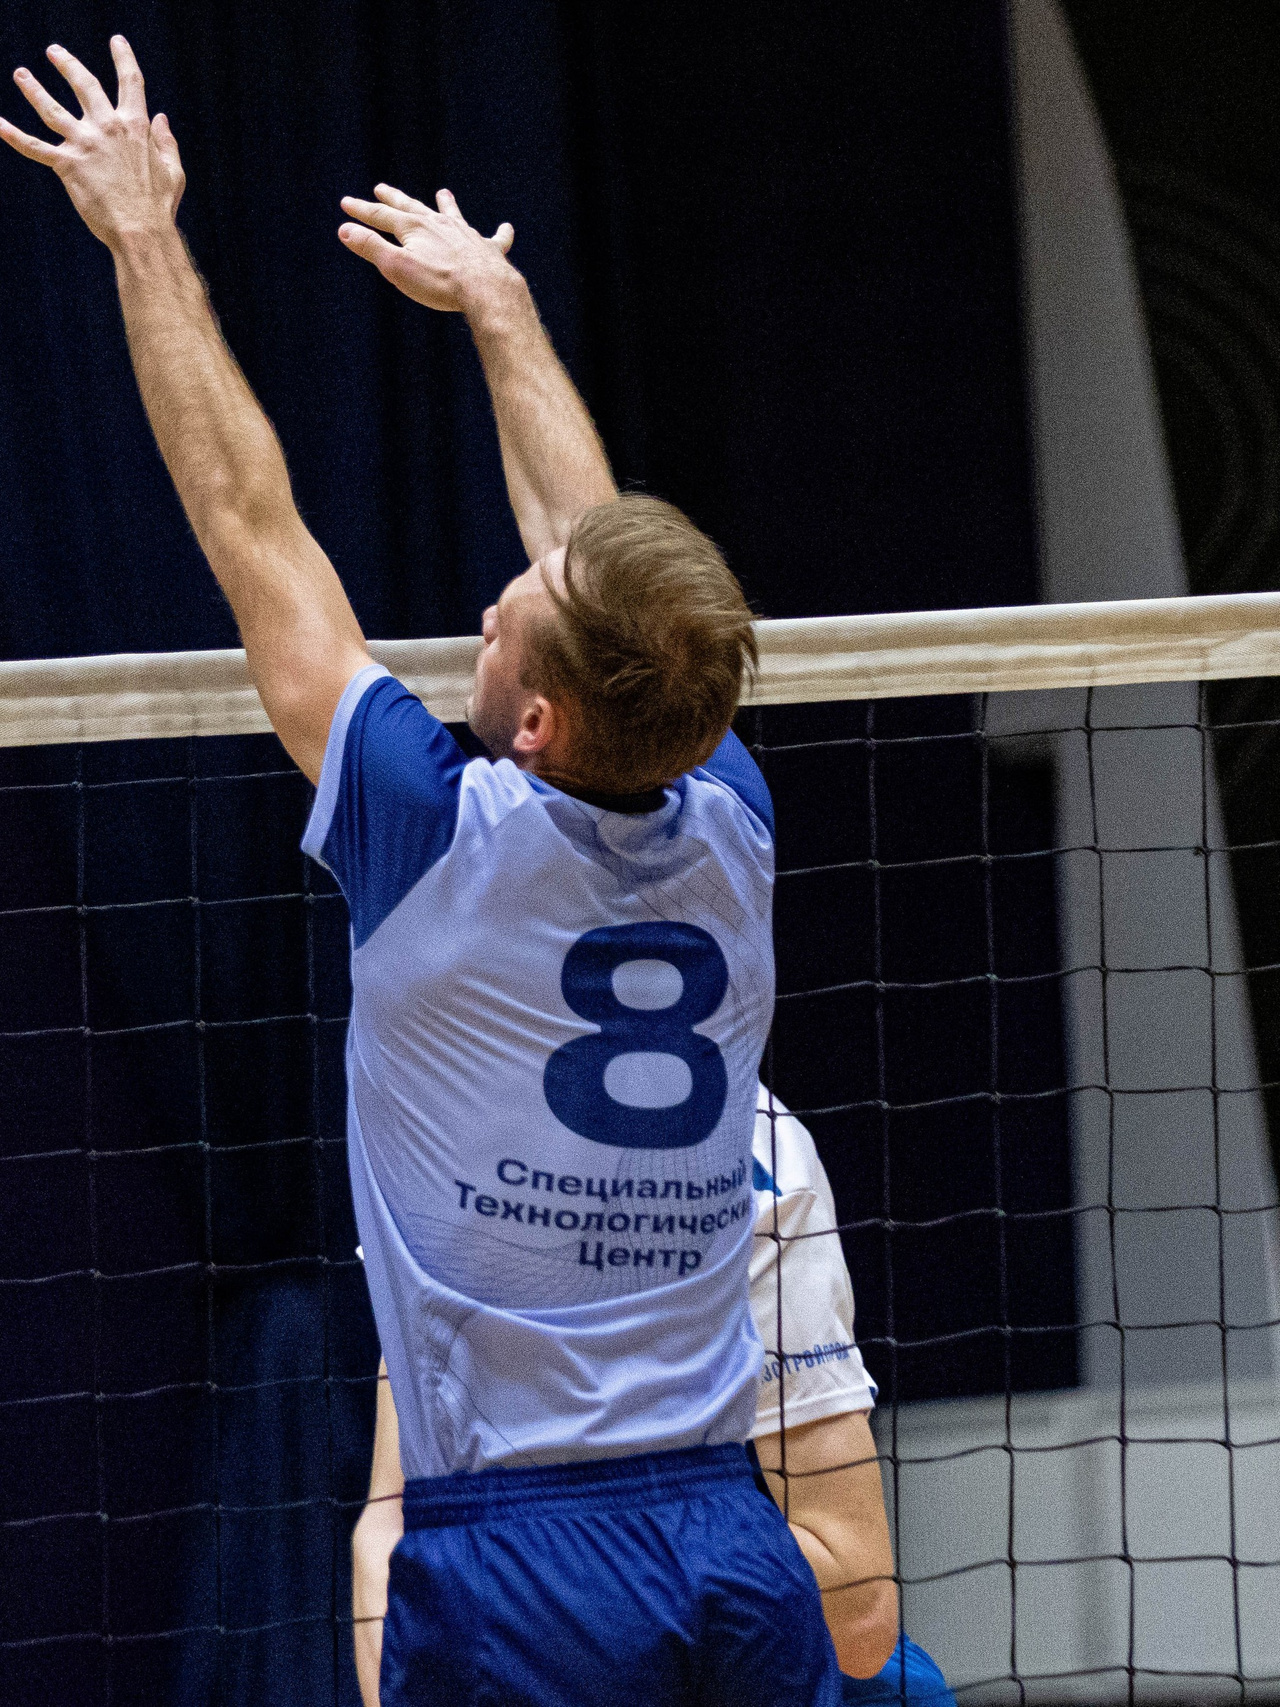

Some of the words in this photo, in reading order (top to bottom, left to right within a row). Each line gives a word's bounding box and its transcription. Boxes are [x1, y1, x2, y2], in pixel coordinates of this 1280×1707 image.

[543, 921, 729, 1150] 8
[497, 1157, 747, 1202] Специальный
[454, 1179, 751, 1236] Технологически
[579, 1241, 702, 1276] Центр
